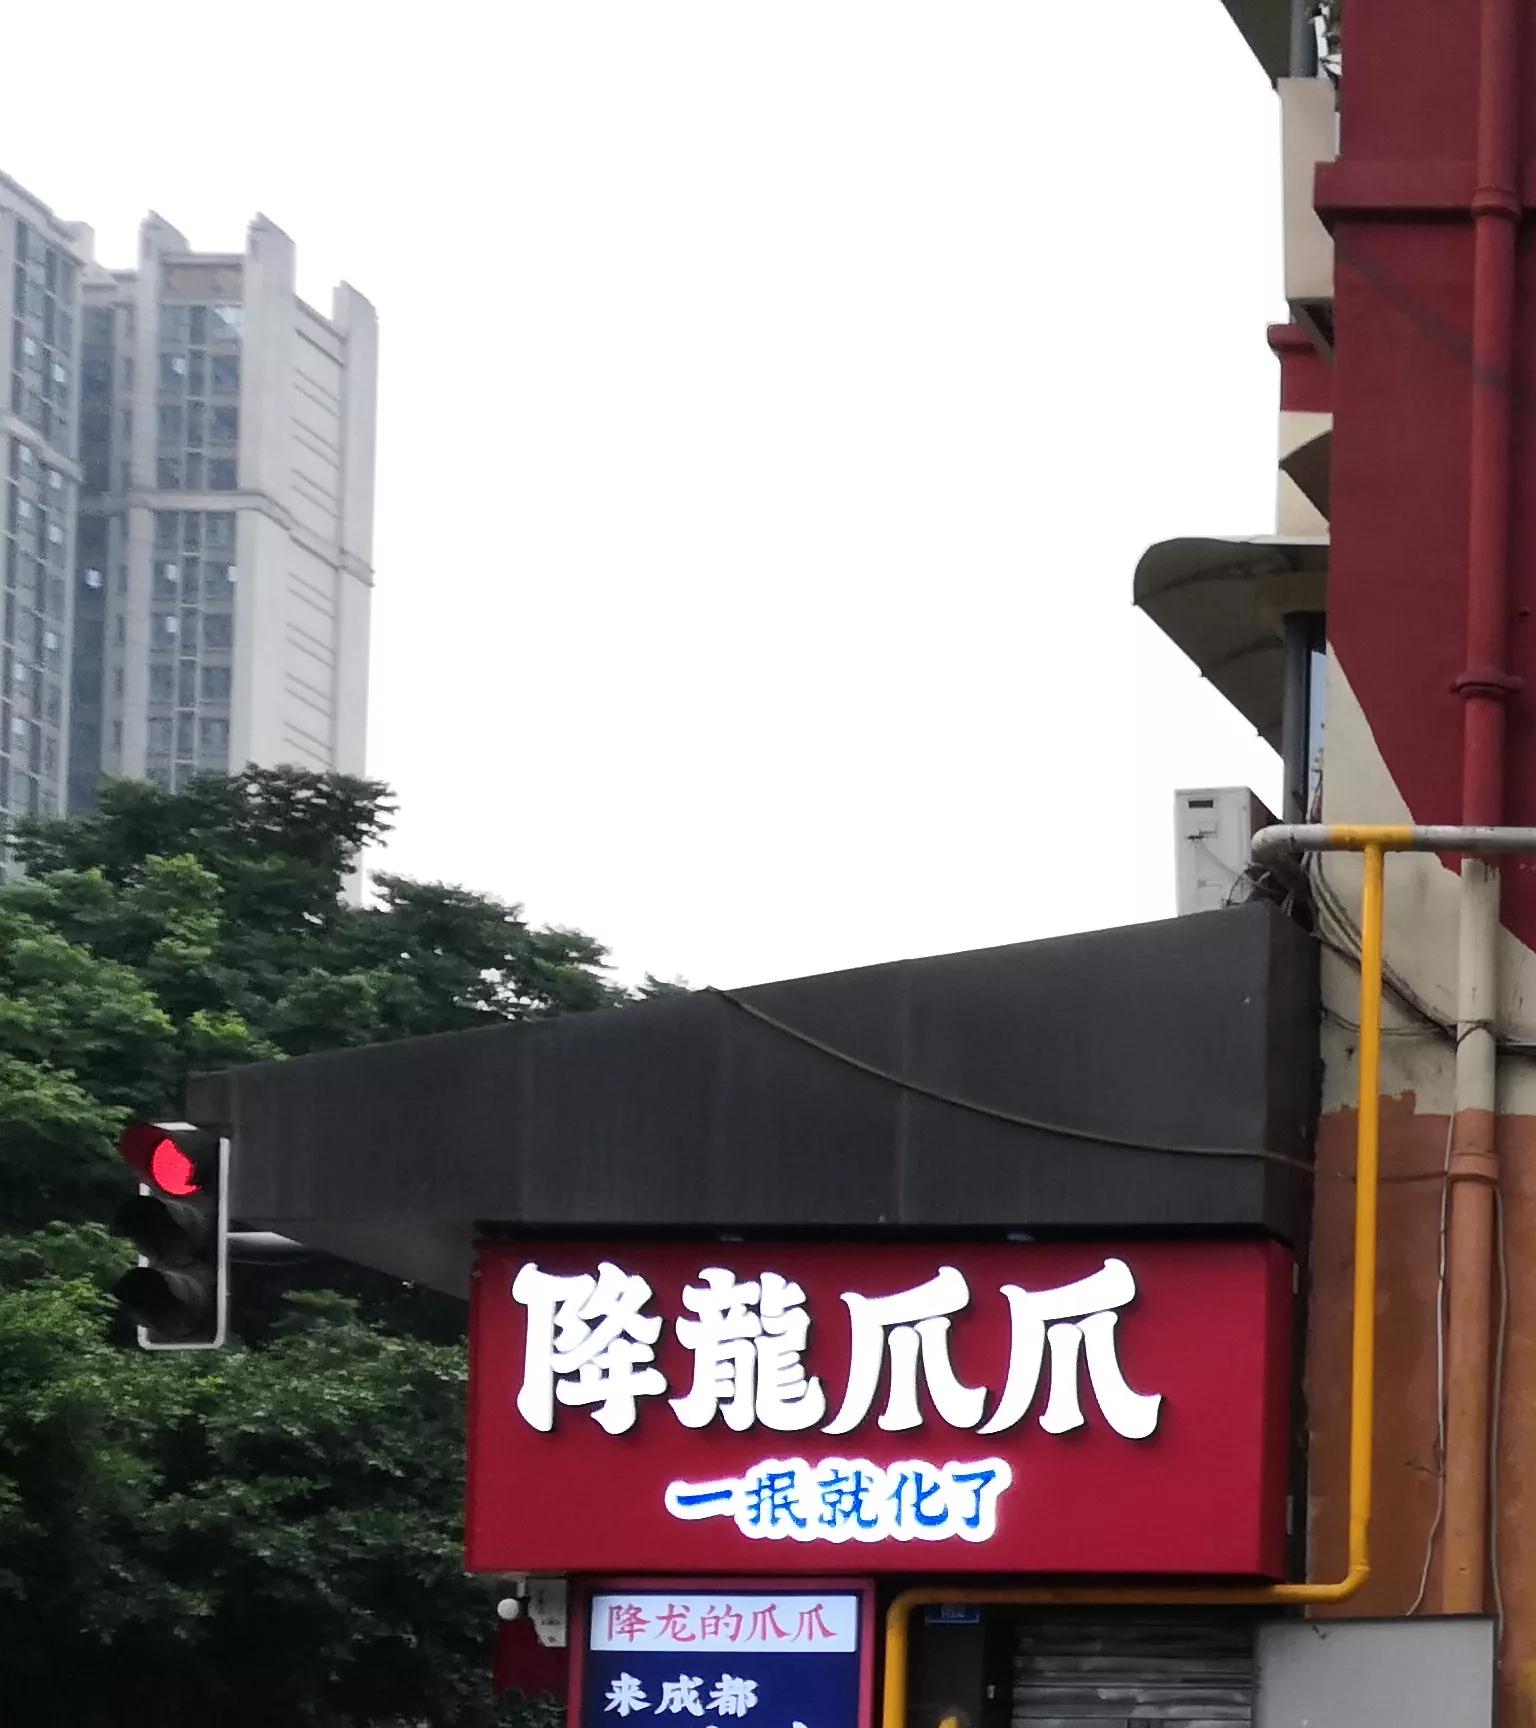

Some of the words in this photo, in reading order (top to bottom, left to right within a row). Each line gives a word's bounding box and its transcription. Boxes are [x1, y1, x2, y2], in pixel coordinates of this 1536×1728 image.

[511, 1257, 1163, 1441] 降龍爪爪
[674, 1466, 1001, 1532] 一抿就化了
[606, 1603, 839, 1643] 降龙的爪爪
[603, 1671, 760, 1718] 来成都
